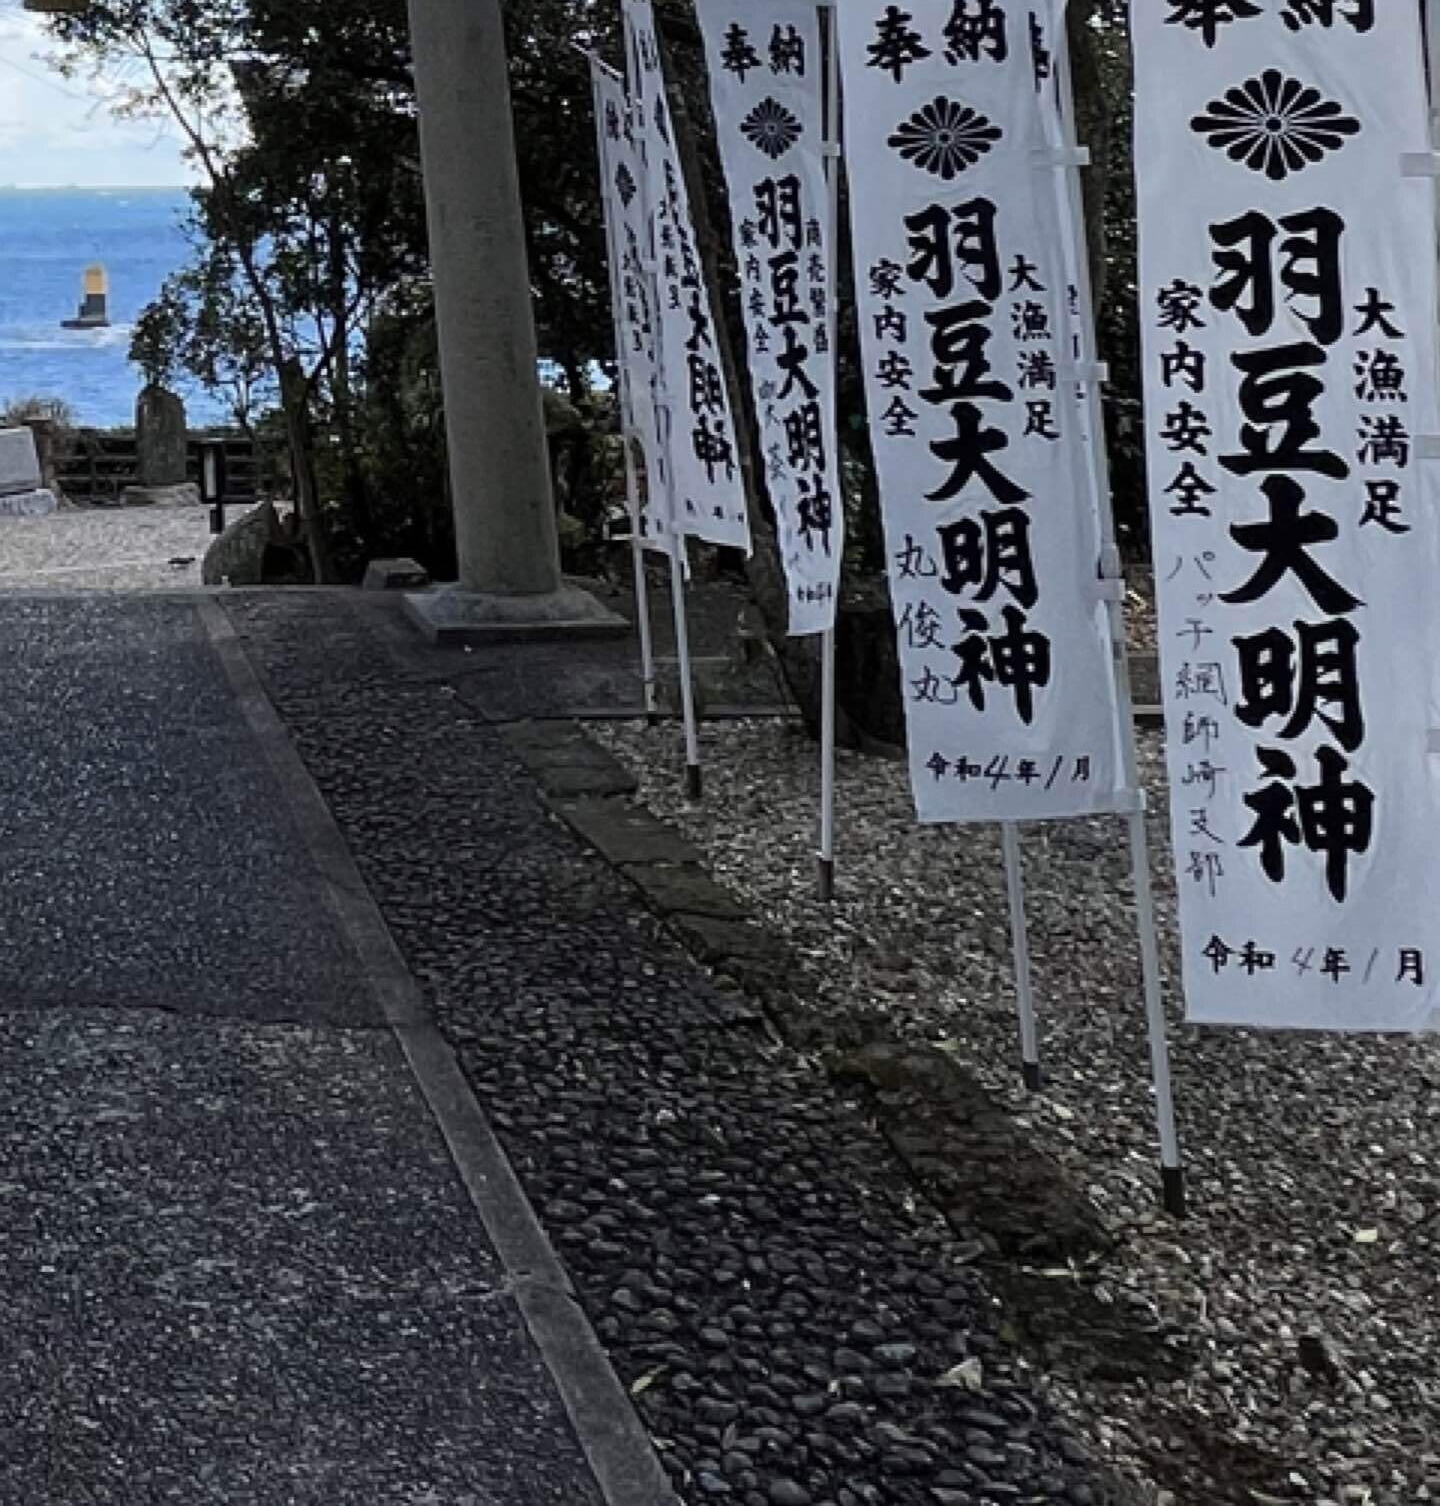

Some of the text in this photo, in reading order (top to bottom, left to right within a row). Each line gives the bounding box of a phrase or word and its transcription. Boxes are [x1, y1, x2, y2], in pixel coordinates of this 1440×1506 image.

[720, 22, 806, 85] 奉納
[738, 217, 771, 354] 家内安全
[754, 174, 832, 557] 羽豆大明神
[868, 257, 919, 437] 家内安全
[1007, 254, 1060, 440] 大漁満足
[903, 197, 1051, 726] 羽豆大明神
[1155, 278, 1217, 518] 家内安全
[1351, 287, 1412, 535] 大漁満足
[1207, 205, 1375, 904] 羽豆大明神
[925, 751, 1091, 790] 令和4年1月
[1201, 934, 1424, 987] 令和4年1月
